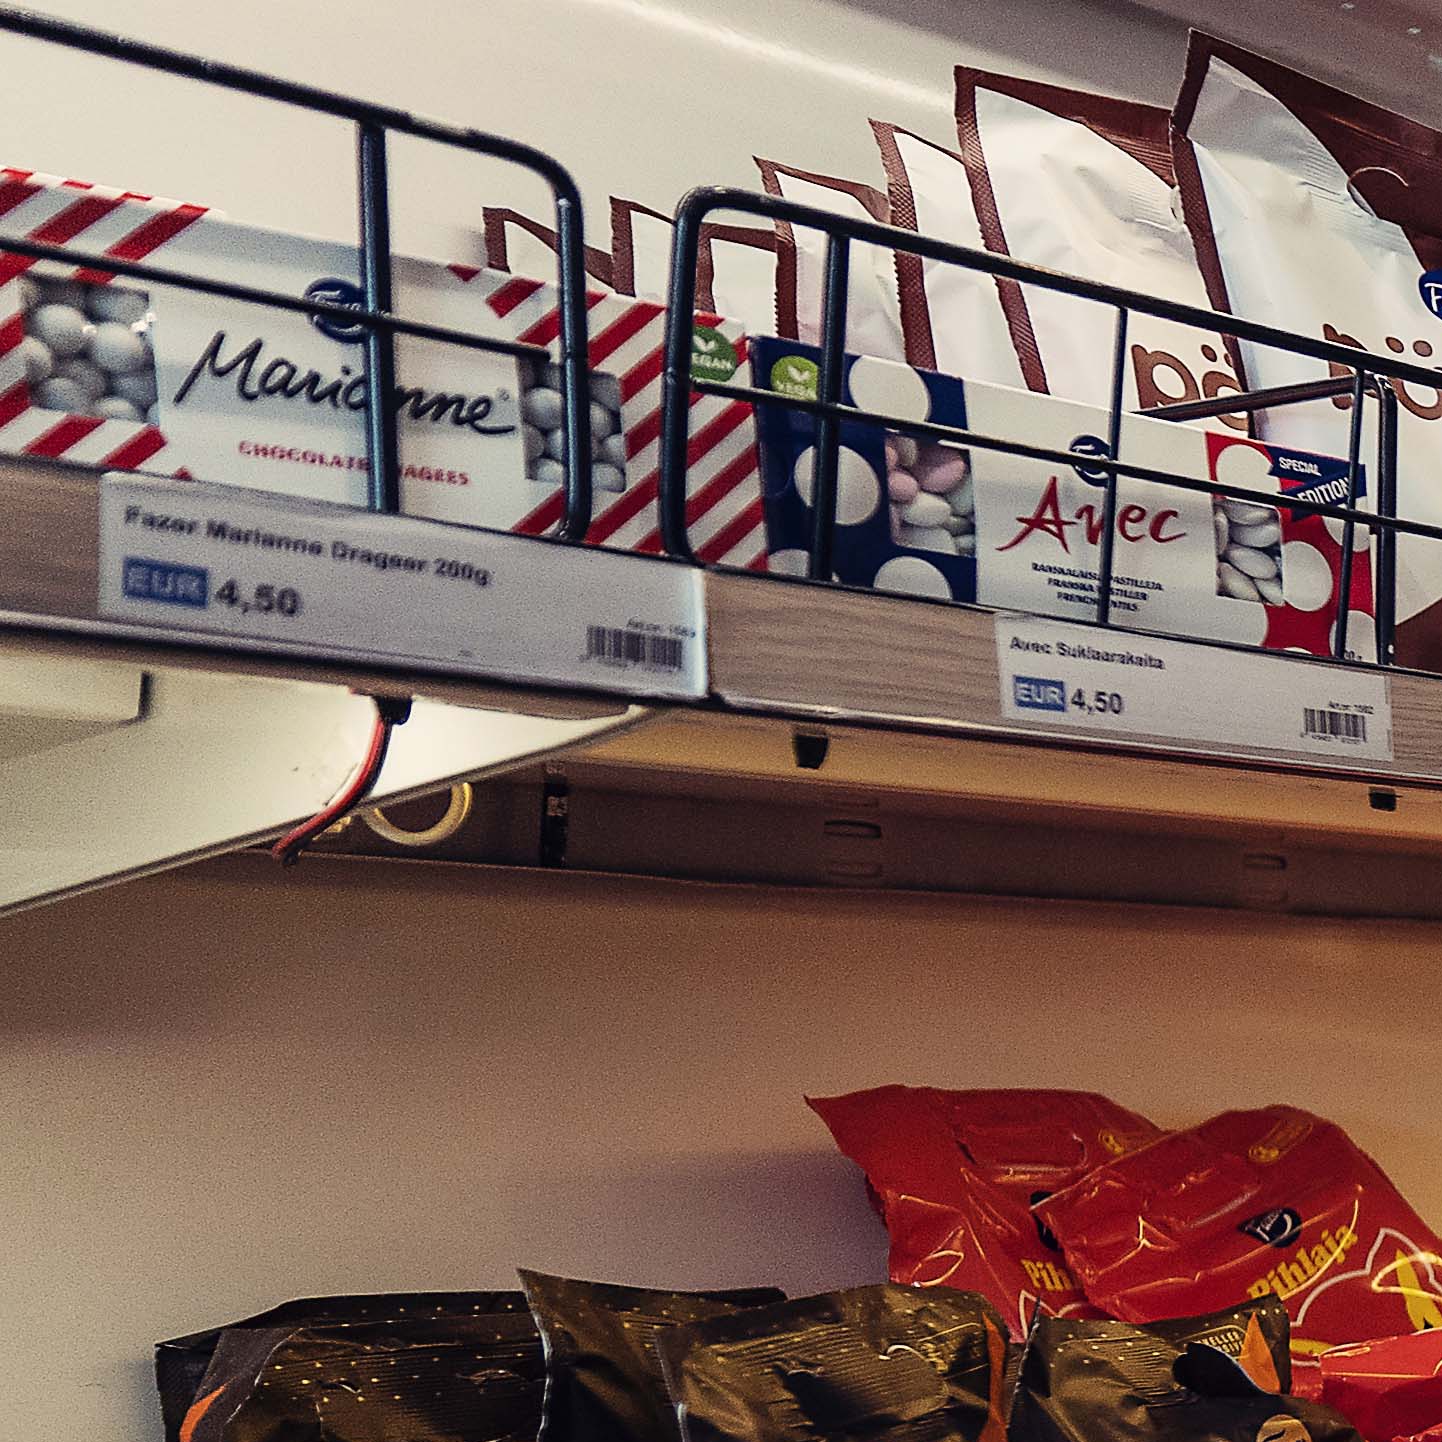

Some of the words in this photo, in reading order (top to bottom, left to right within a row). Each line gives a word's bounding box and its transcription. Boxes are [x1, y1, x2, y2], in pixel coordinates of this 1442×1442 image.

[1278, 456, 1322, 477] SPECIAL
[122, 504, 200, 537] Fazer
[214, 578, 300, 617] 4,50
[1017, 682, 1061, 706] EUR
[1071, 690, 1123, 716] 4,50
